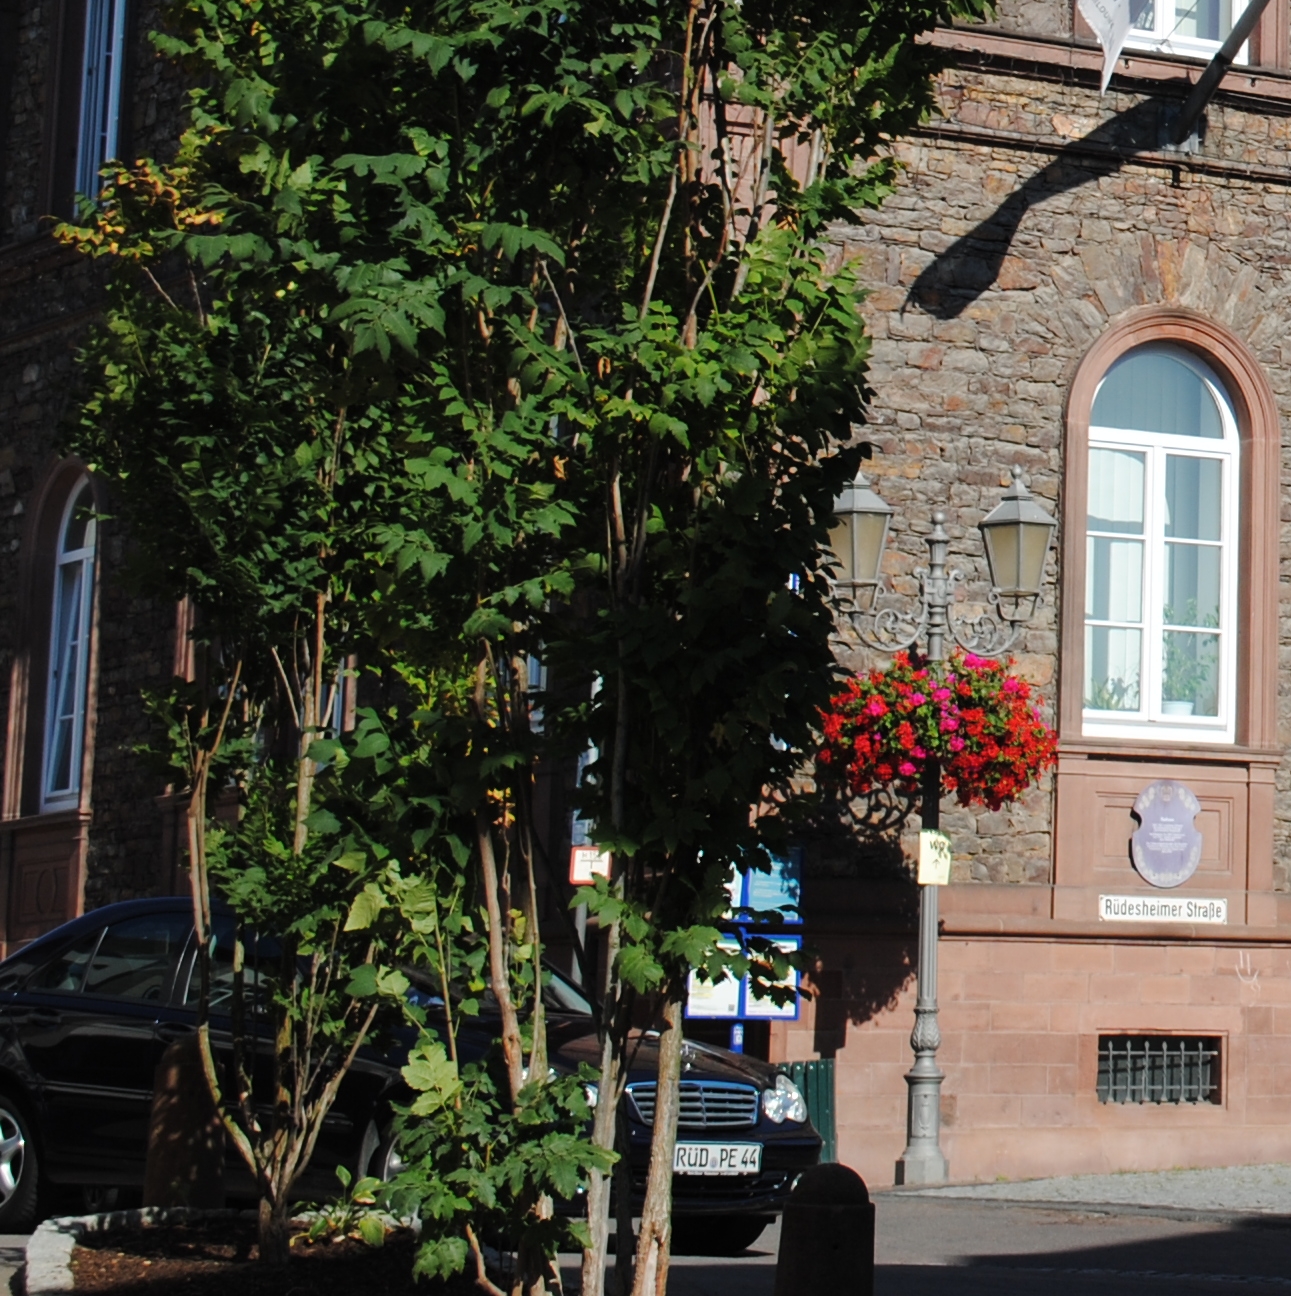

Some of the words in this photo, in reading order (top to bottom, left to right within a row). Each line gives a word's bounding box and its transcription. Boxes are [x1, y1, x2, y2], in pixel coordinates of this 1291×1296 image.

[1105, 898, 1183, 918] Rüdesheimer
[1186, 901, 1222, 921] Straße
[676, 1147, 709, 1168] RÜD
[720, 1148, 738, 1168] PE
[741, 1148, 757, 1168] 44
